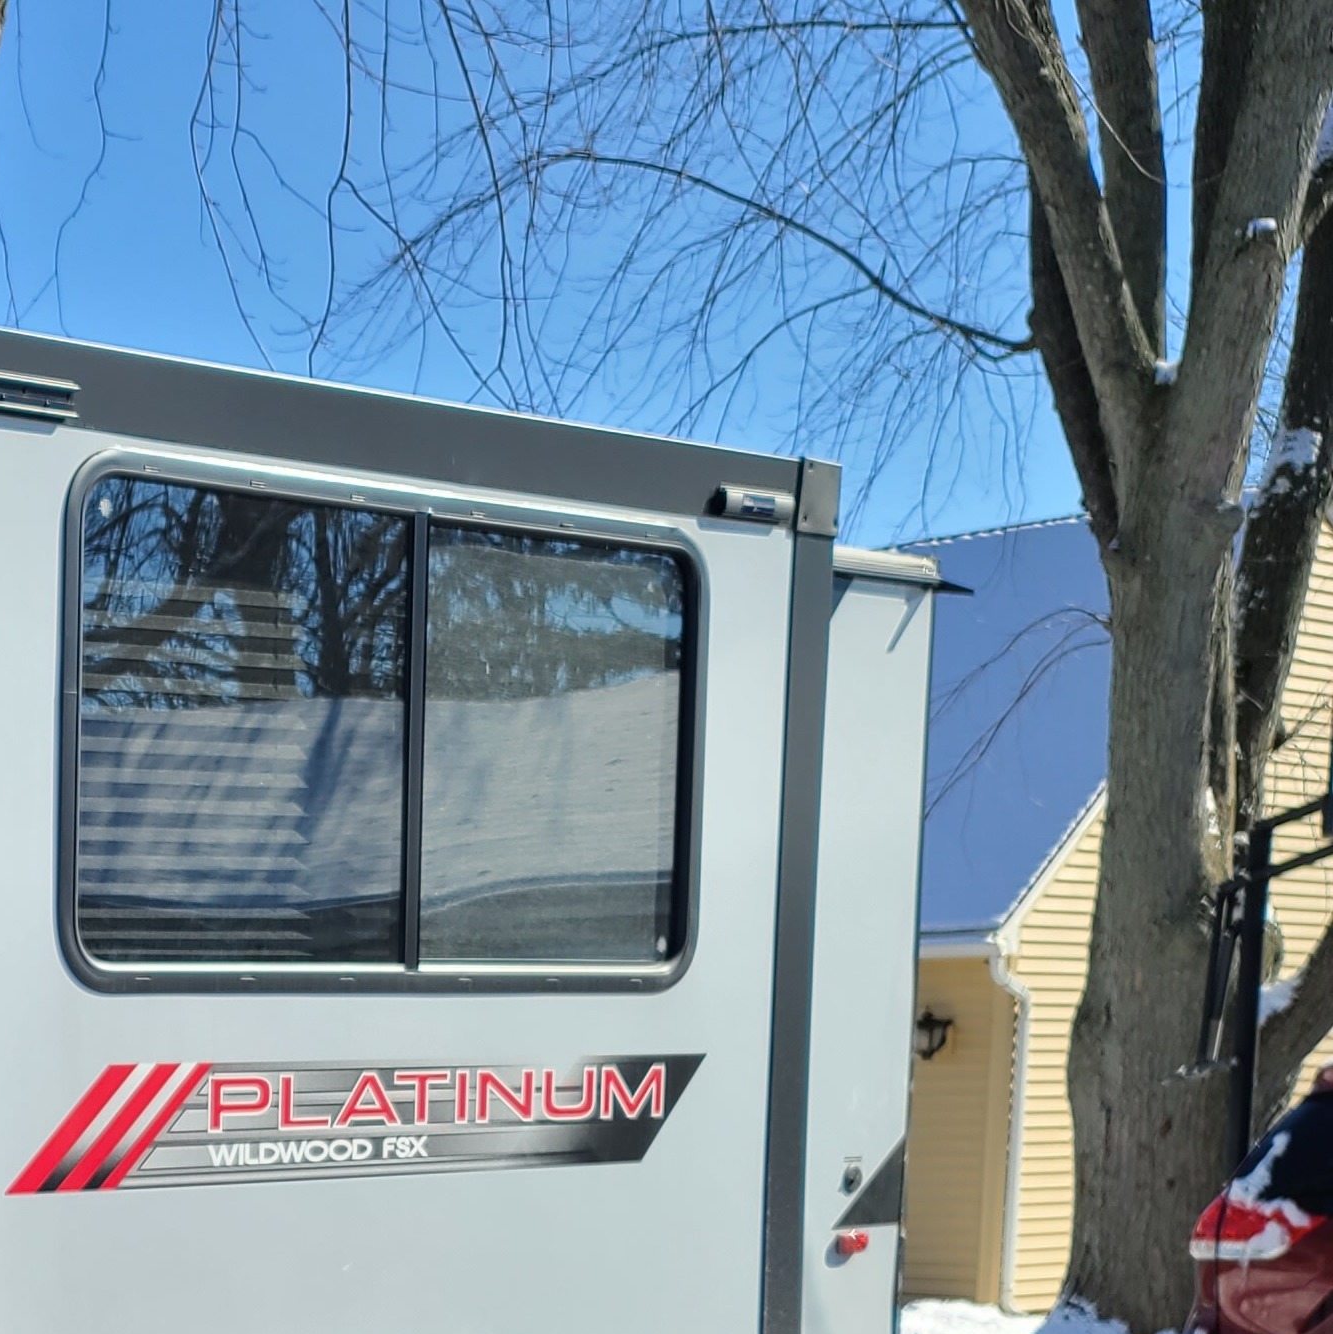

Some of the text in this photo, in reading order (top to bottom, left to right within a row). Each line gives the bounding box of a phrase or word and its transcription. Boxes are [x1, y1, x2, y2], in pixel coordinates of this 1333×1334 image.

[207, 1064, 666, 1133] PLATINUM
[209, 1136, 429, 1167] WILDWOOD FSX
